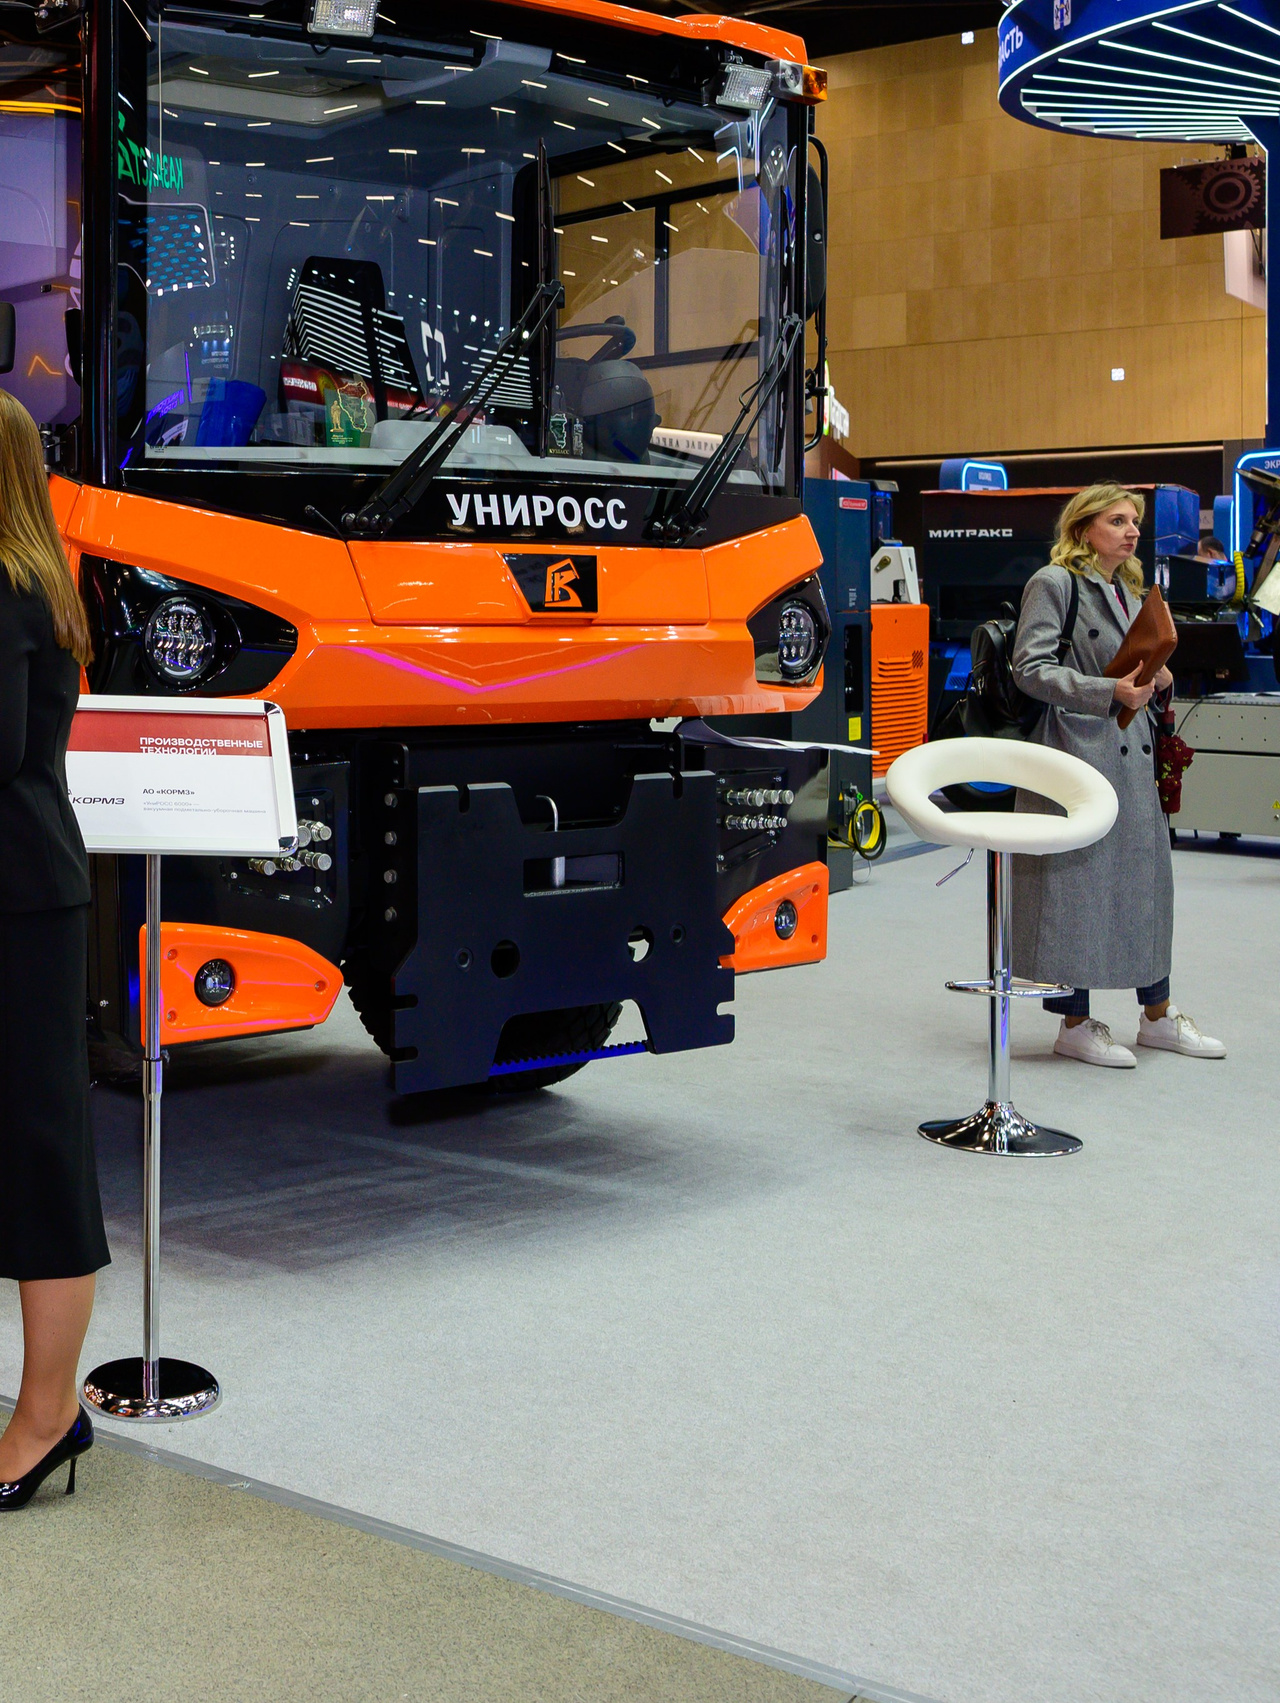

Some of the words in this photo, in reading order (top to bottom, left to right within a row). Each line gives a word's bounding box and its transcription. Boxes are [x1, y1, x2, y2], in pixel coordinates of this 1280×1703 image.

[446, 493, 629, 530] УНИРОСС
[928, 528, 1013, 538] МИТРАКС
[139, 737, 264, 749] ПРОИЗВОДСТВЕННЫЕ
[140, 746, 218, 756] ТЕХНОЛОГИИ
[156, 788, 196, 796] «КОРМЗ»
[72, 797, 126, 805] КОРМЗ
